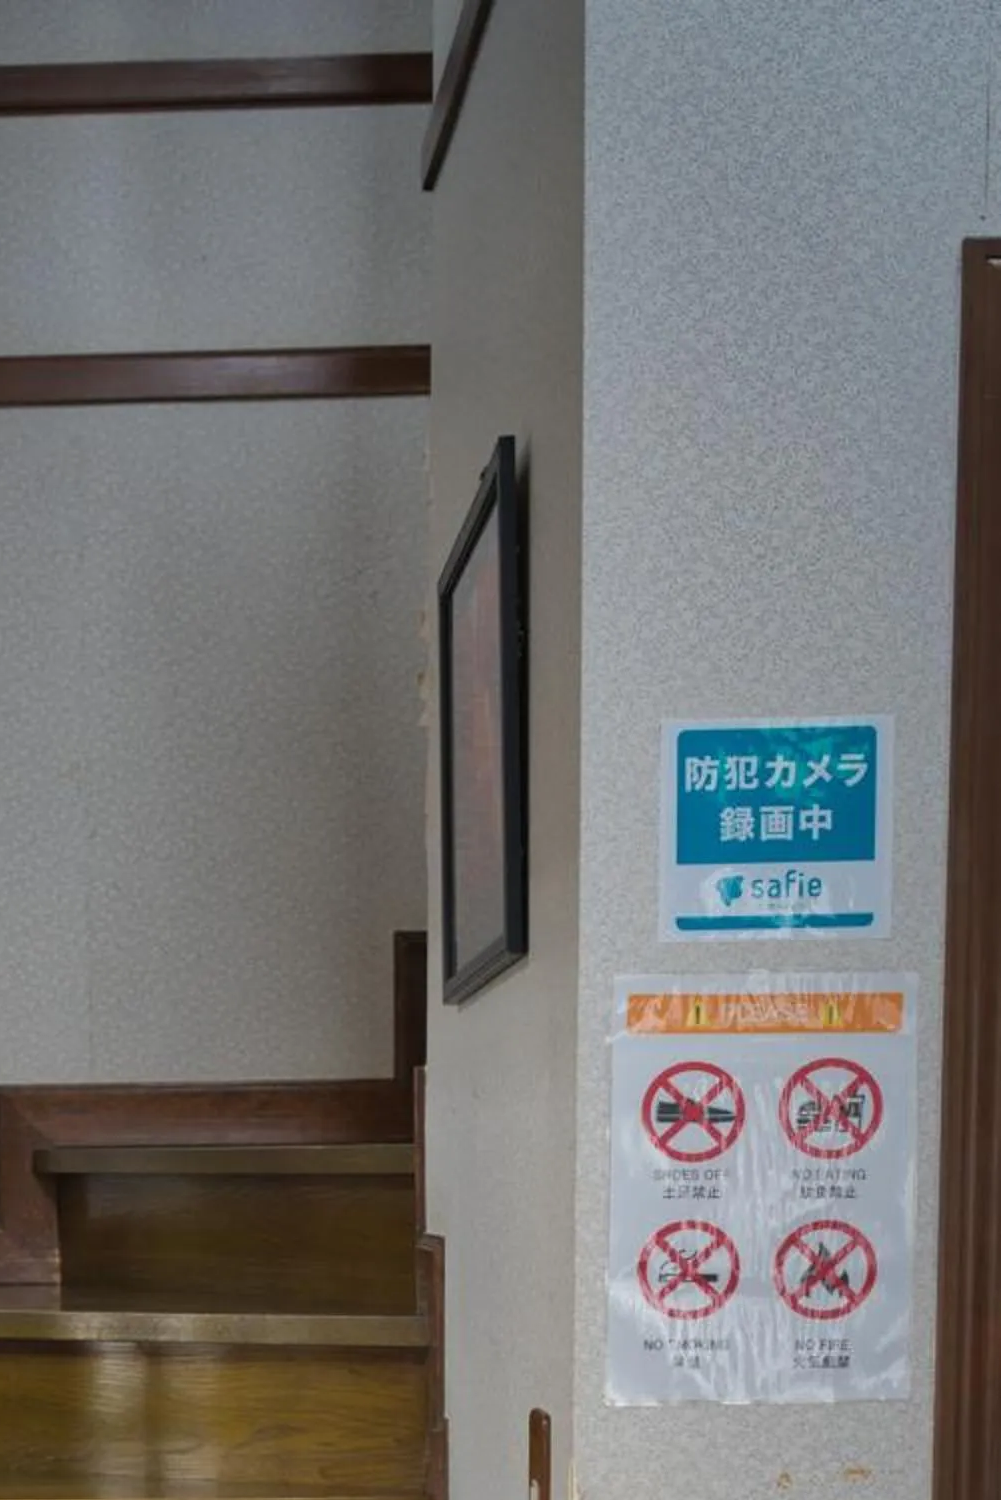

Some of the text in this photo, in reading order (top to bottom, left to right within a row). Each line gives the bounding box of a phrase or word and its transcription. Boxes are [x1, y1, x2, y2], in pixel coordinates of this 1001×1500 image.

[684, 752, 869, 793] 防犯カメラ
[718, 803, 833, 843] 録画中
[750, 869, 823, 899] safie
[816, 1168, 867, 1181] EATNG
[643, 1338, 664, 1351] NO
[795, 1338, 814, 1351] NO
